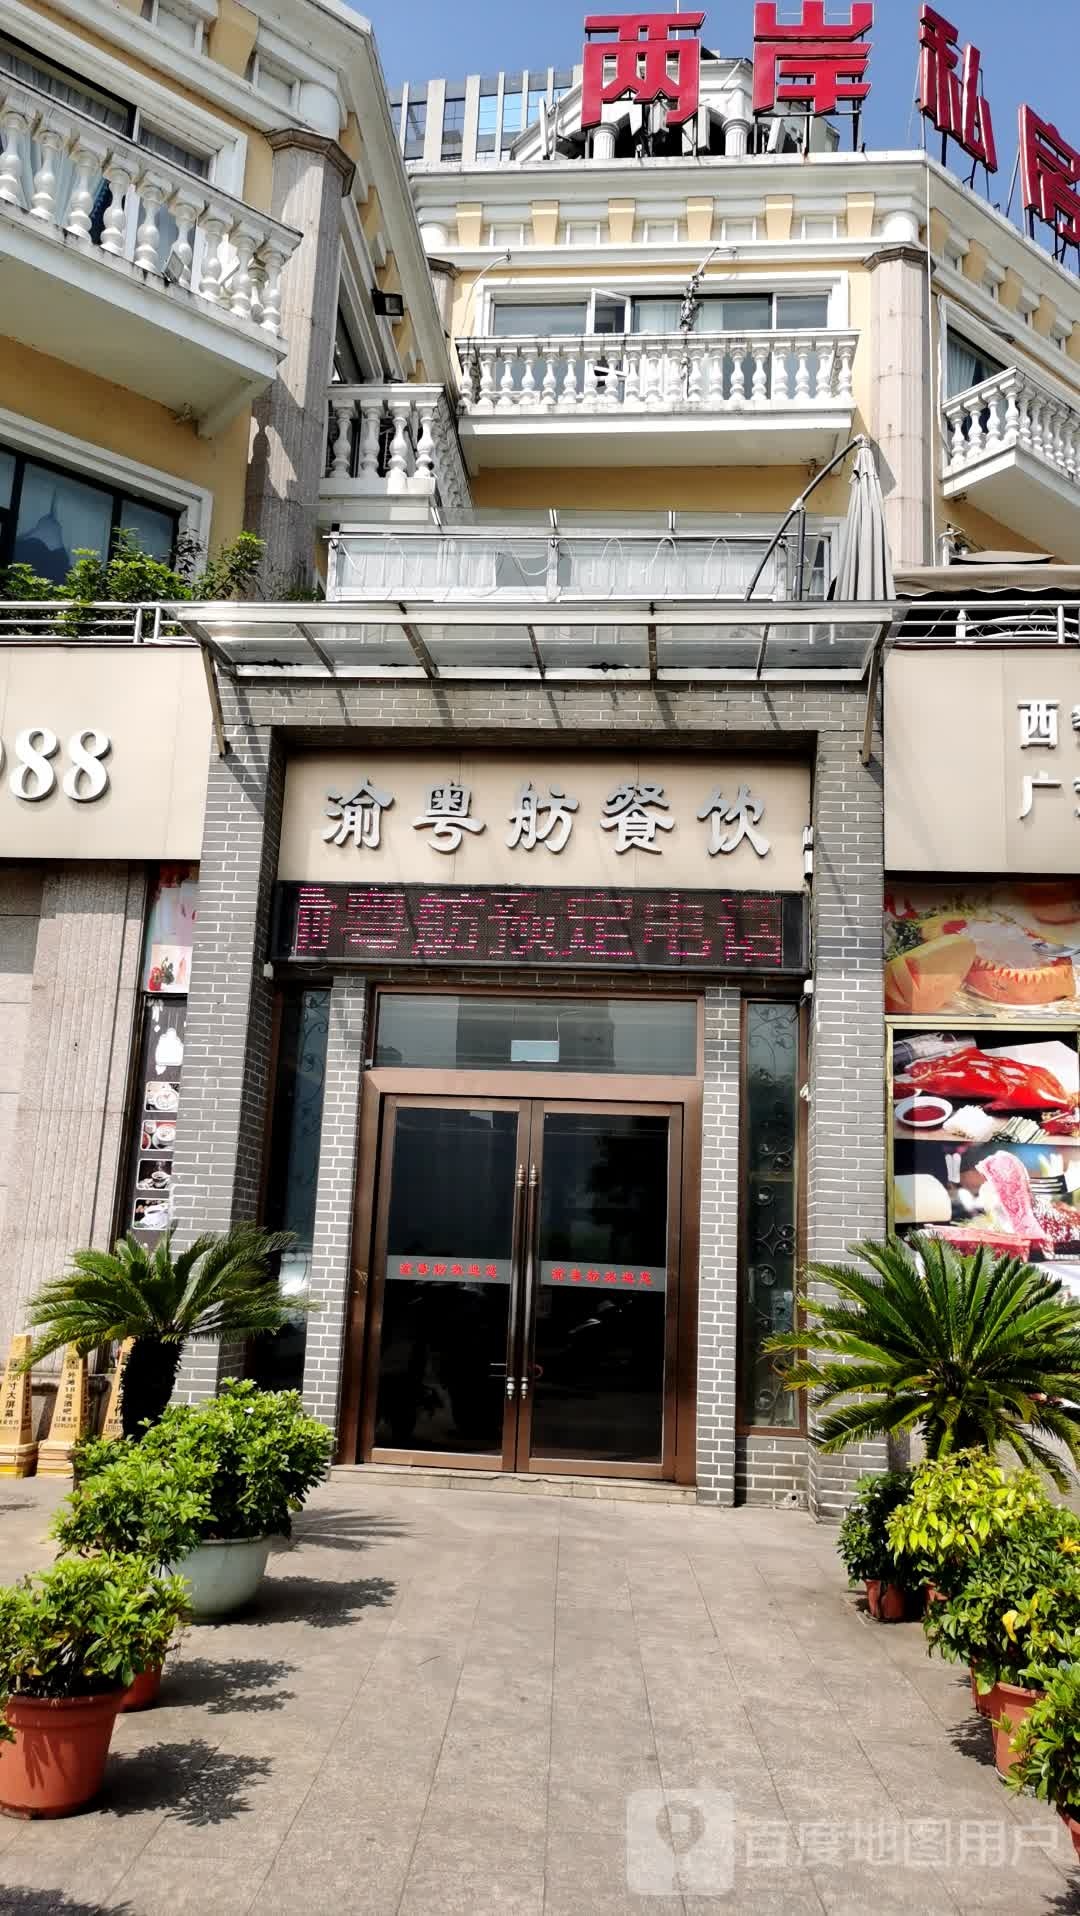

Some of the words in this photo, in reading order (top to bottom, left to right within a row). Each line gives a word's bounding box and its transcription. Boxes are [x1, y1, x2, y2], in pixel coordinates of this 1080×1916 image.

[1017, 699, 1080, 749] 西
[0, 728, 112, 803] 88
[1017, 769, 1080, 821] 广
[321, 778, 772, 857] 渝粤舫餐饮
